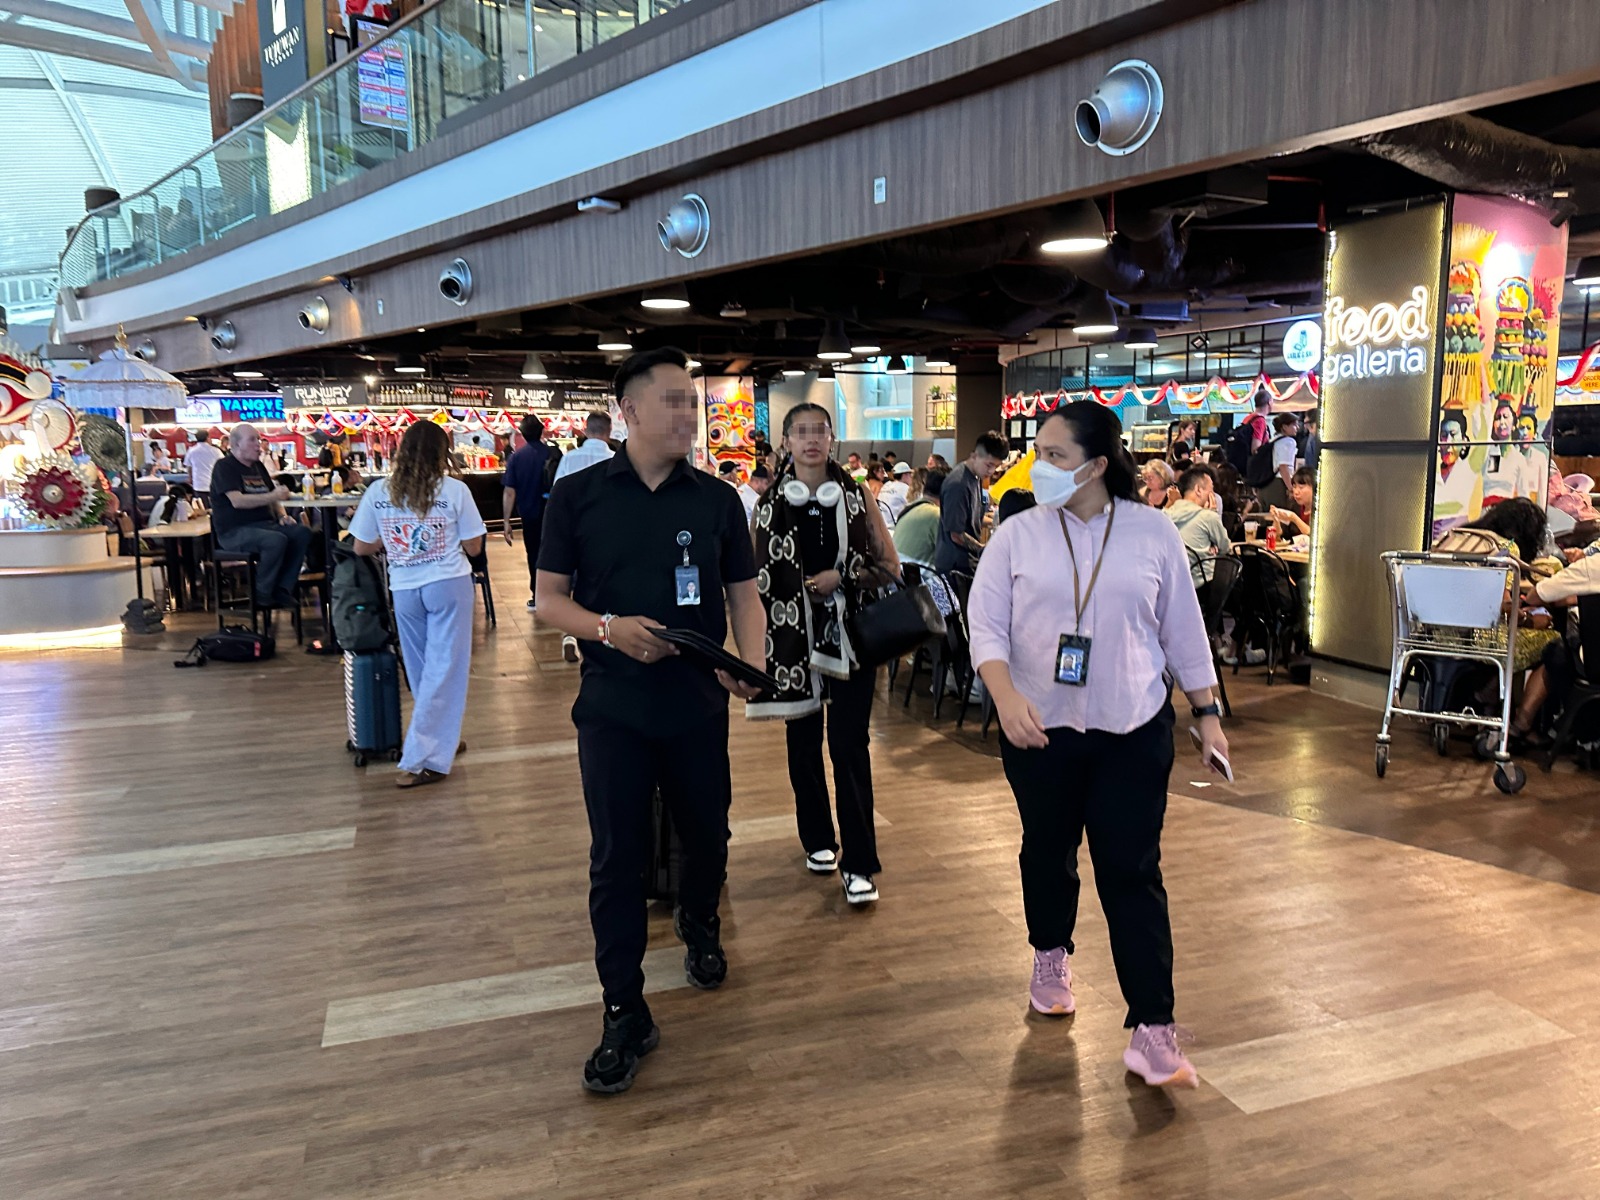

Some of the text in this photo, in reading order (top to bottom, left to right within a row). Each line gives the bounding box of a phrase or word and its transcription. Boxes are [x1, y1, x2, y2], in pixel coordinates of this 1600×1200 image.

[1324, 286, 1429, 346] food
[1322, 340, 1426, 384] galleria
[294, 385, 352, 400] RUNWAY
[504, 388, 554, 401] RUNWAY
